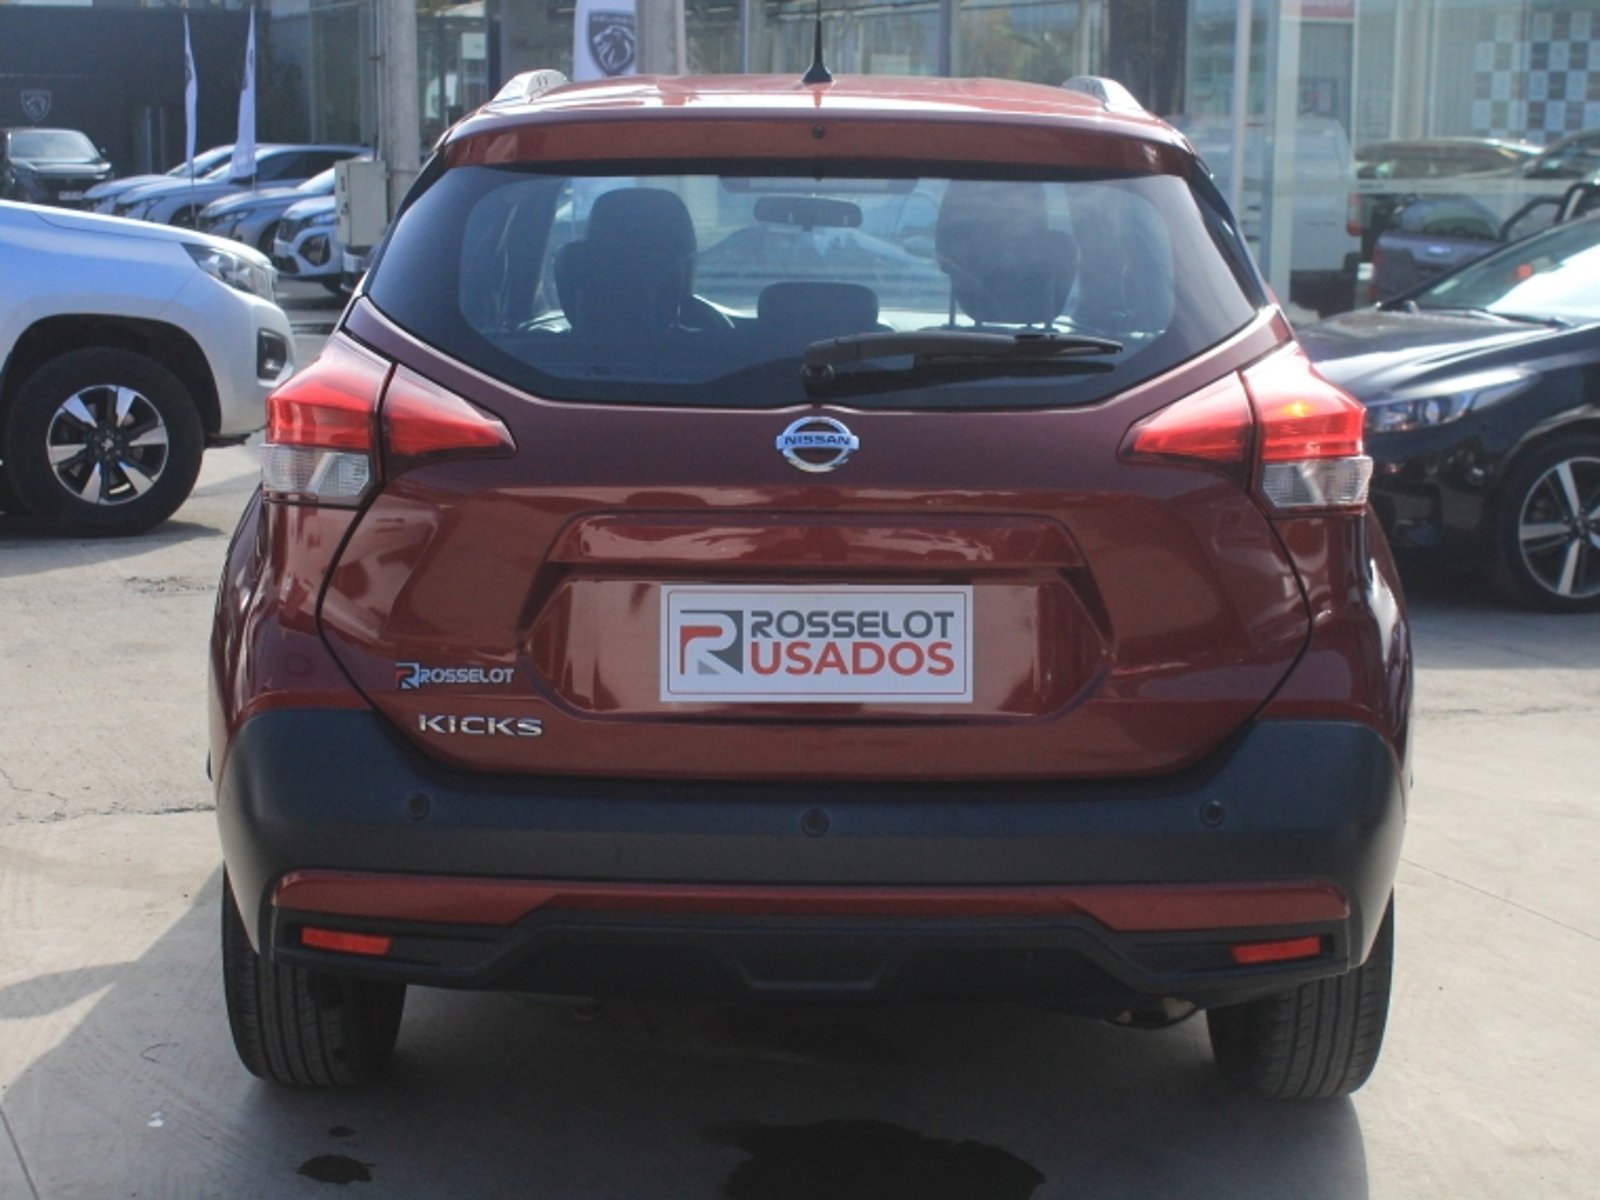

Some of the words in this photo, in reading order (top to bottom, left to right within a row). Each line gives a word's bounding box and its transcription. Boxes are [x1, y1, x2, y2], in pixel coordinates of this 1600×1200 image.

[784, 434, 850, 446] NISSAN
[751, 610, 955, 639] ROSSELOT
[750, 641, 955, 677] USADOS
[420, 668, 515, 684] ROSSELOT
[418, 713, 543, 737] KICKS
